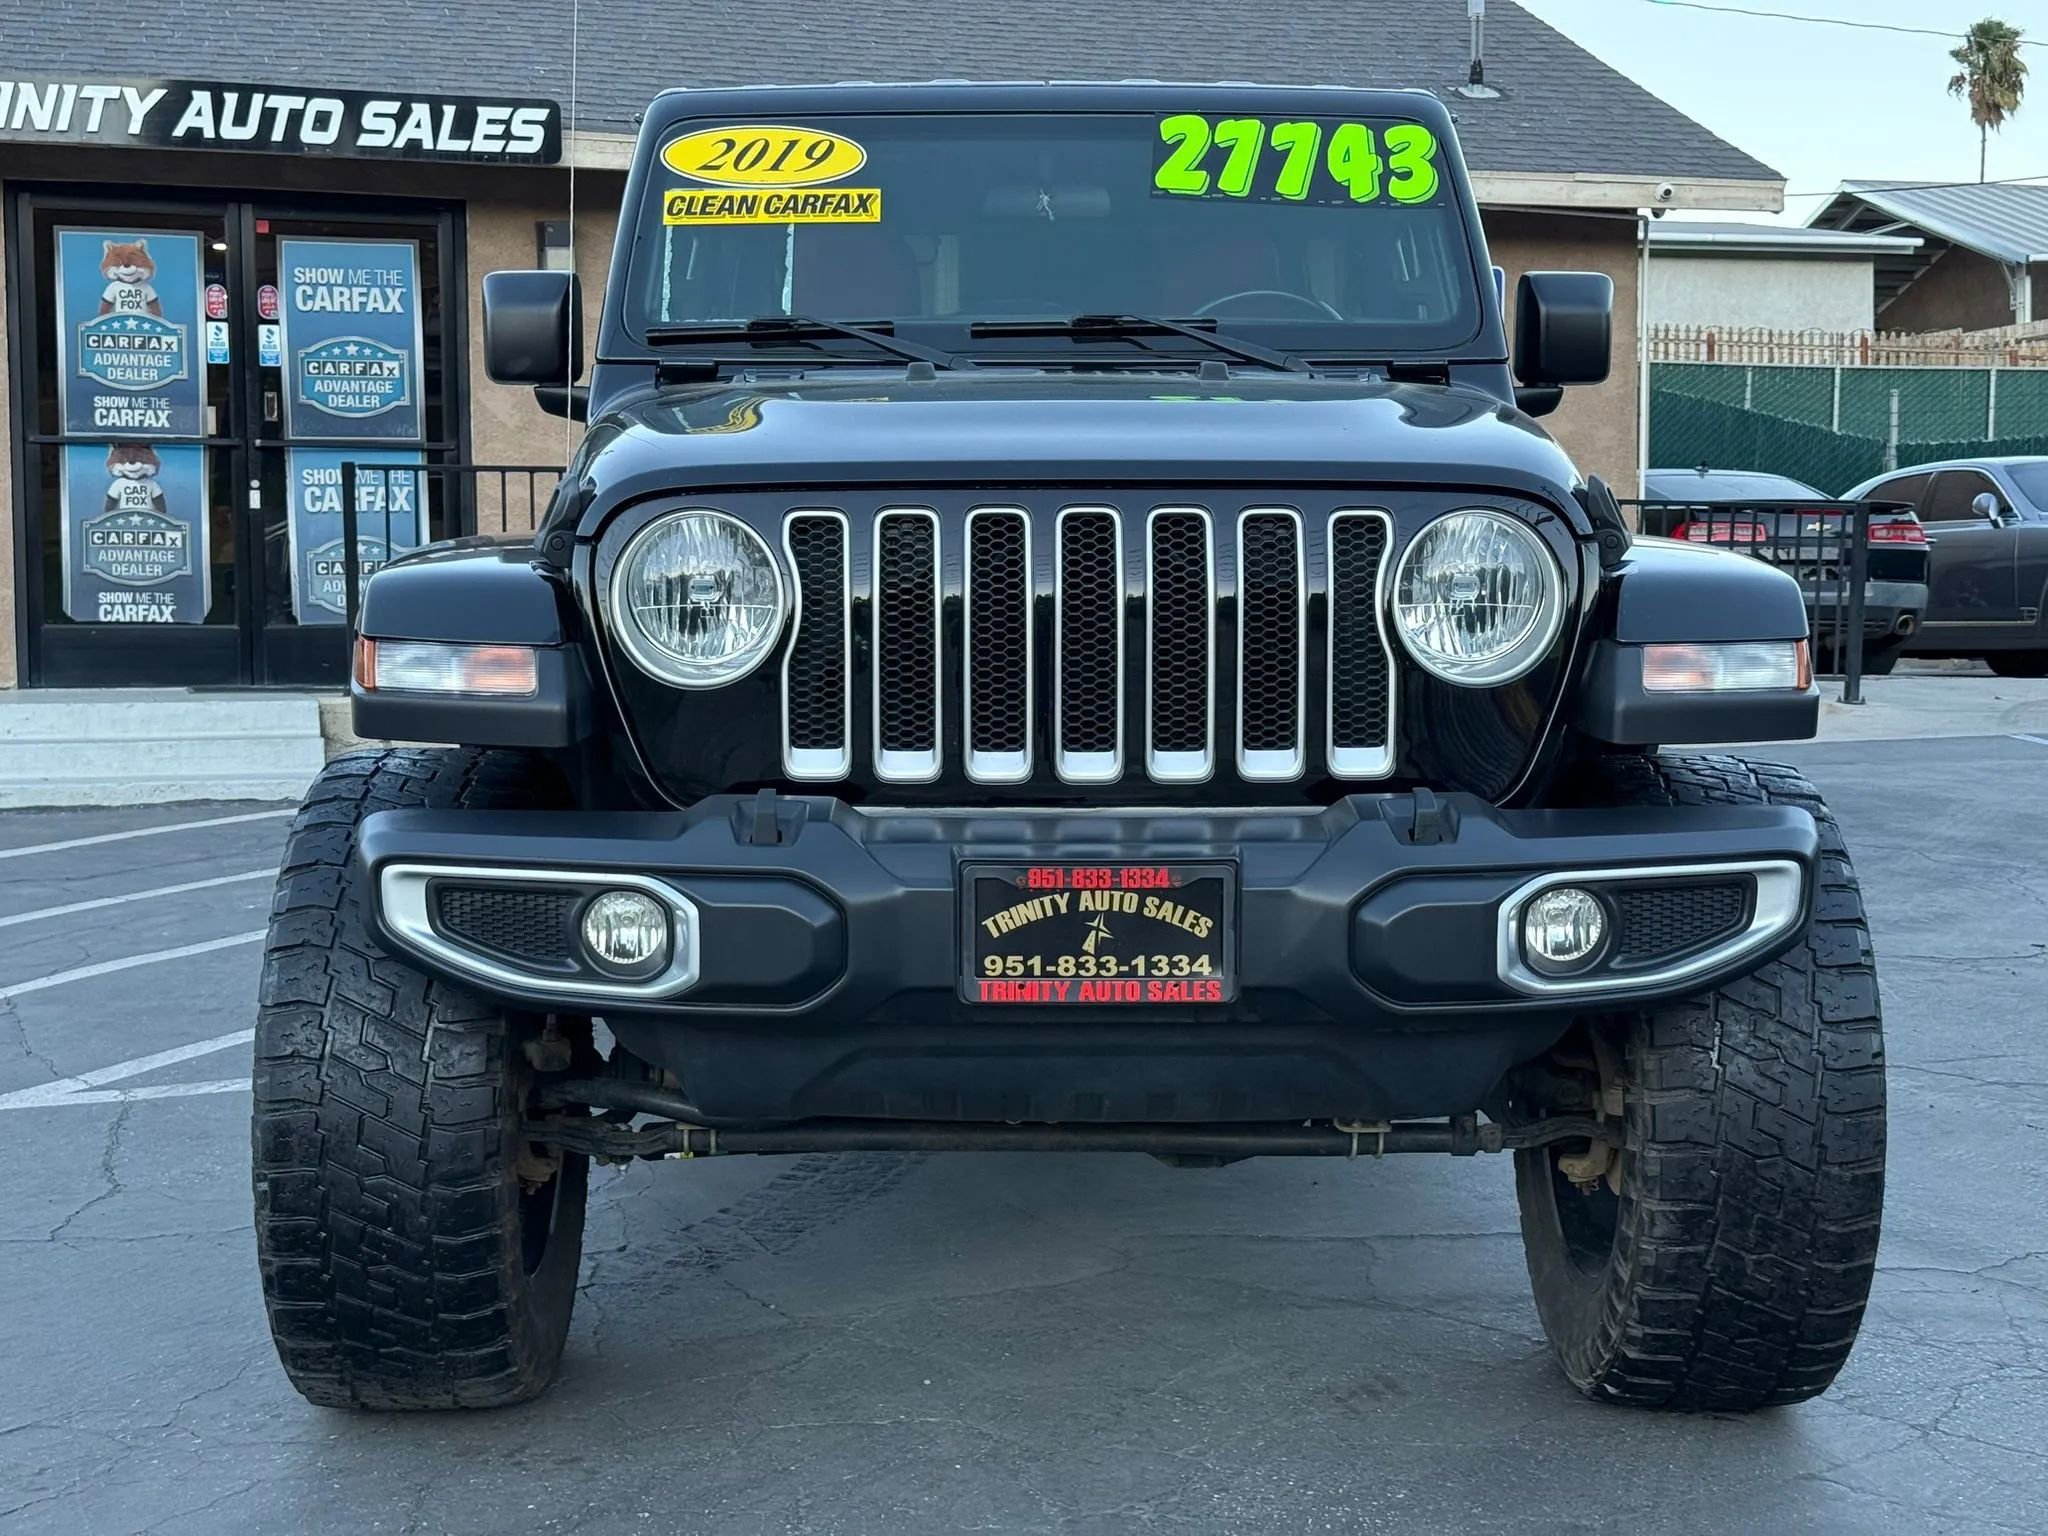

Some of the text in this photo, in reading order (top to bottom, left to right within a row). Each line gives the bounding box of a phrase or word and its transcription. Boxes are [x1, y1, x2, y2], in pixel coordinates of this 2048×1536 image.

[172, 90, 345, 145] AUTO
[356, 100, 550, 154] SALES
[695, 138, 835, 172] 2019
[1155, 114, 1439, 204] 27743
[666, 193, 878, 219] CLEAN CARFAX
[294, 267, 403, 286] SHOW ME THE
[119, 289, 142, 299] CAR
[295, 285, 405, 313] CARFAX
[121, 300, 142, 309] FOX
[87, 335, 176, 351] CARFAX
[94, 353, 172, 367] ADVANTAGE
[107, 368, 158, 381] DEALER
[307, 361, 398, 376] CARFAX
[314, 380, 394, 393] ADVANTAGE
[94, 396, 170, 409] SHOW ME THE
[328, 394, 380, 408] DEALER
[94, 409, 171, 428] CARFAX
[356, 469, 380, 484] ME
[386, 469, 411, 485] HE
[124, 486, 147, 495] CAR
[126, 496, 147, 506] FOX
[304, 486, 412, 513] CAFAX
[91, 532, 180, 547] CARFAX
[98, 550, 175, 563] ADVANTAGE
[112, 564, 163, 576] DEALER
[98, 592, 174, 604] SHOW ME THE
[99, 605, 176, 623] CARFAX
[1027, 868, 1170, 889] 951-833-1334
[981, 890, 1214, 939] TRINITY AUTO SALES
[984, 954, 1212, 977] 951-833-1334
[977, 980, 1223, 1001] TRINITY AUTO SALES
